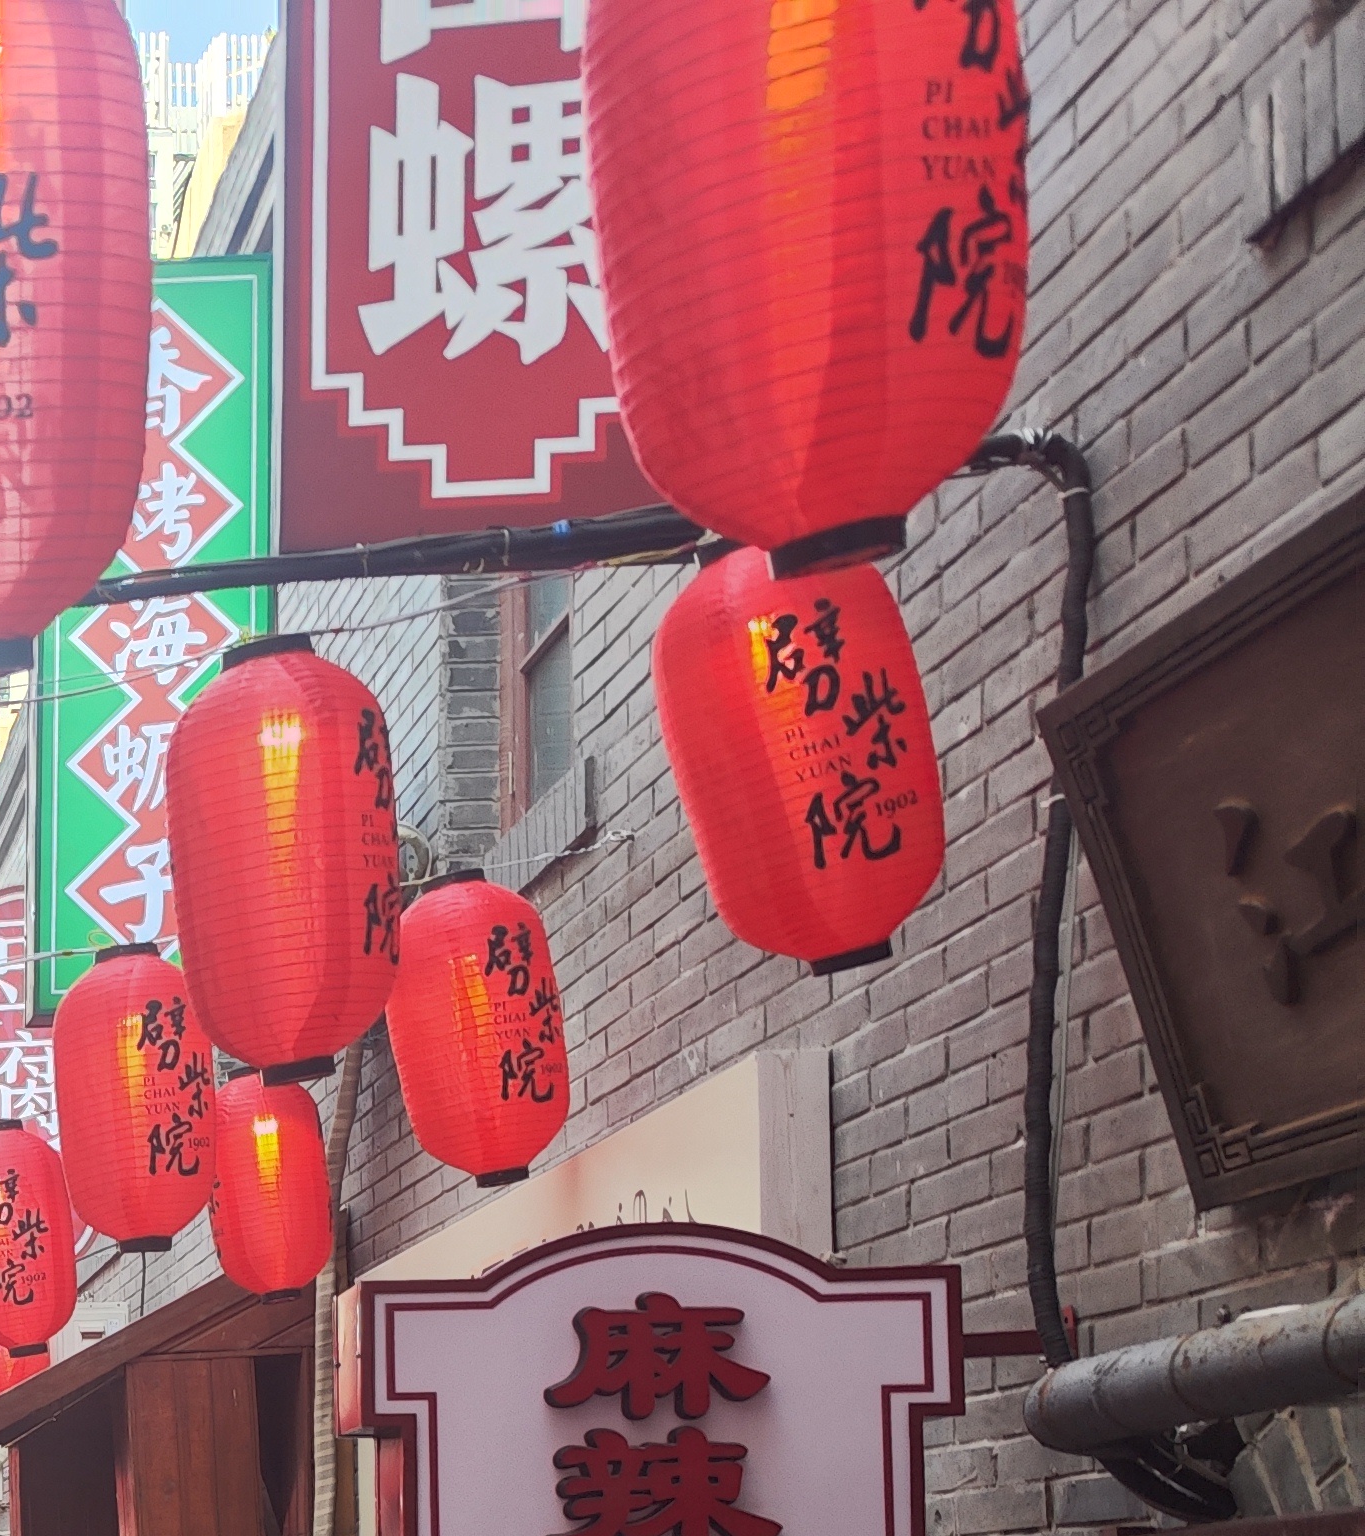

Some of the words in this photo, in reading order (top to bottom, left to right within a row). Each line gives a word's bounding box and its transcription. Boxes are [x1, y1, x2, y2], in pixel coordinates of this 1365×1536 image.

[925, 77, 954, 105] PI
[921, 115, 993, 142] CHAI
[921, 154, 997, 181] YUAN
[766, 598, 907, 870] 劈柴院
[784, 727, 806, 744] PI
[788, 733, 843, 763] CHAI
[793, 755, 853, 785] YUAN
[875, 790, 919, 819] 1902
[485, 922, 563, 1104] 劈柴院
[493, 1001, 507, 1013] PI
[492, 1012, 527, 1026] CHAI
[494, 1027, 531, 1042] YUAN
[137, 996, 211, 1177] 劈柴院
[143, 1075, 157, 1087] PI
[144, 1085, 177, 1100] CHAI
[144, 1102, 181, 1117] YUAN
[187, 1135, 211, 1150] 1902
[20, 1271, 48, 1286] 1902
